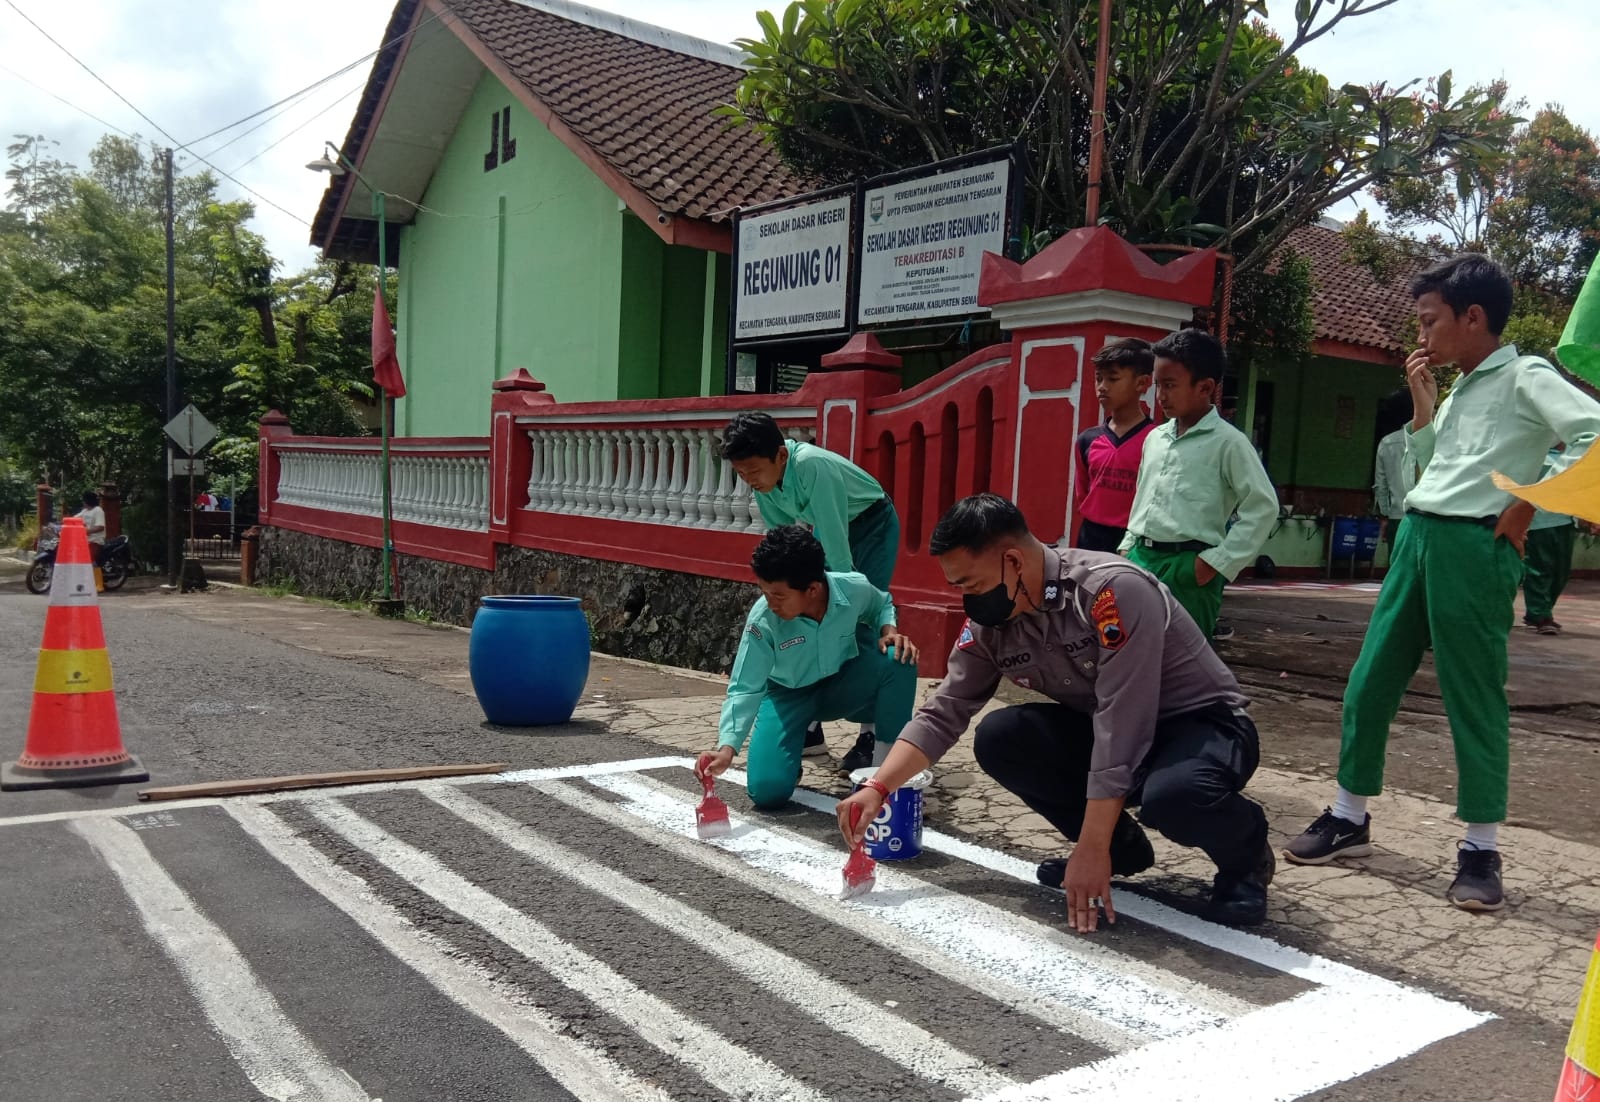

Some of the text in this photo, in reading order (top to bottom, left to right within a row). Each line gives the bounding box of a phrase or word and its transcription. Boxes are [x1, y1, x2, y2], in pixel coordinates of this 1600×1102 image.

[895, 171, 995, 200] PEMERINTAH KABUPATEN SEMARANG
[887, 185, 1002, 217] UPTD PENDIDIKAN KECAMATAN TENGARAN
[759, 207, 846, 238] SEKOLAH DASAR NEGERI
[866, 211, 1000, 253] SEKOLAH DASAR NEGERI REGUNUNG 01
[894, 246, 965, 267] TERAKREDITASI B
[743, 244, 841, 297] REGUNUNG 01
[906, 265, 945, 279] KEPUTUSAN
[864, 295, 977, 316] KECAMATAN TENGARAN, KABUPATEN SEMA
[739, 318, 763, 329] KECAMATAN
[788, 312, 815, 325] KABUPATEN
[815, 309, 841, 322] SEMARANG
[865, 824, 892, 842] OP
